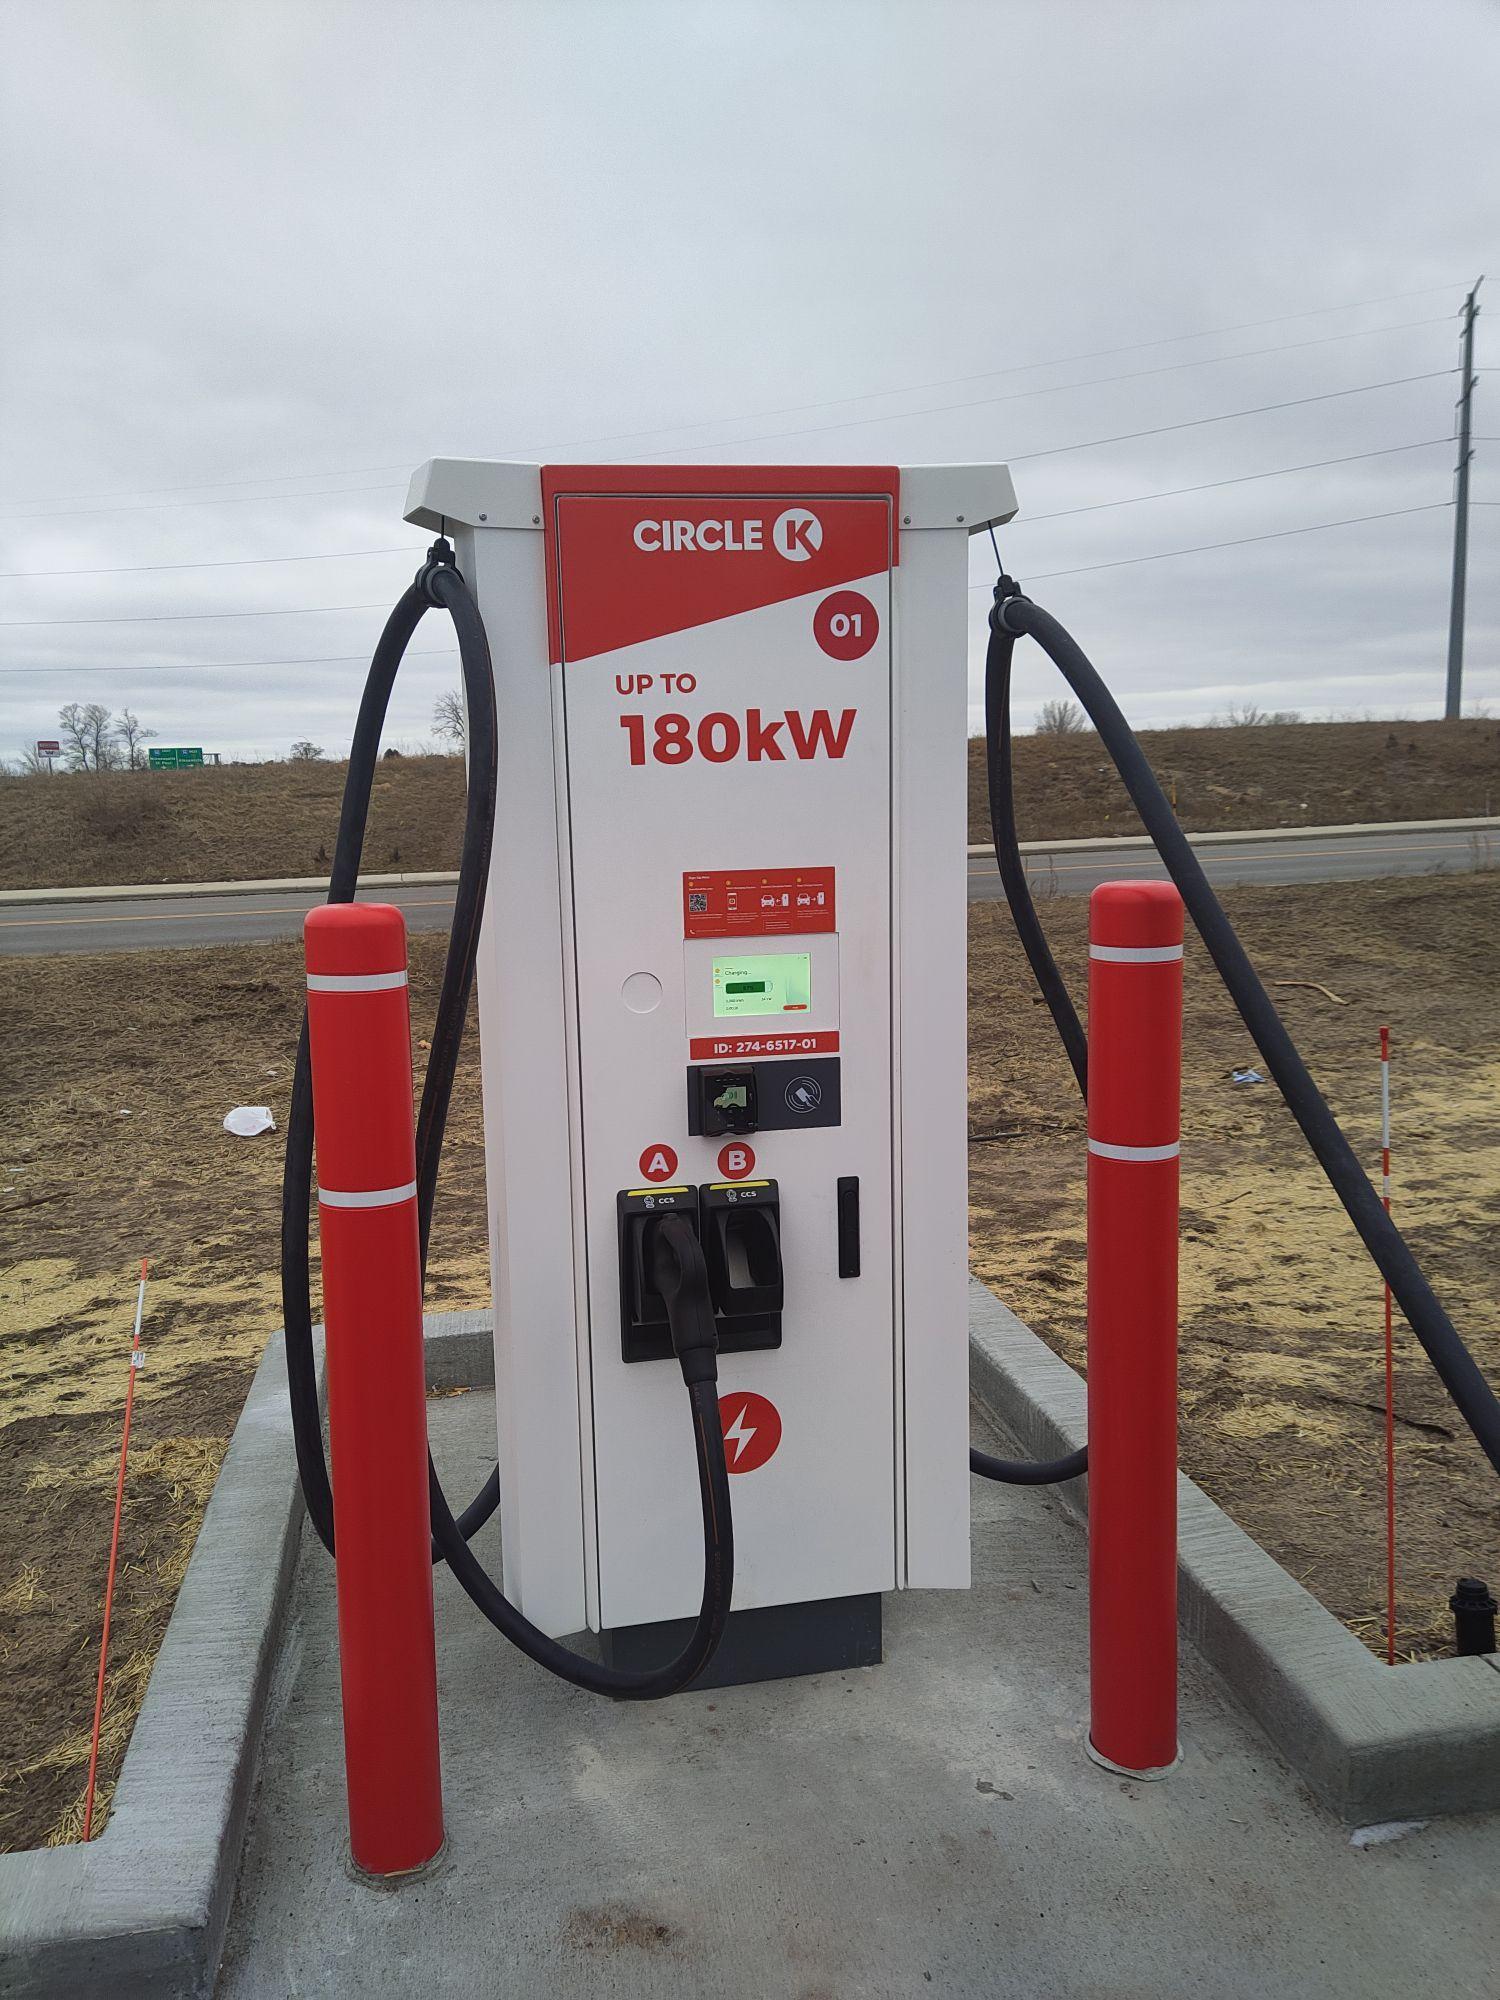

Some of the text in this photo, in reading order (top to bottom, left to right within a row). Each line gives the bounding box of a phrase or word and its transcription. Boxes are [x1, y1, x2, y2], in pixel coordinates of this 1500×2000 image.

[633, 518, 820, 558] CIRCLE K
[829, 613, 863, 638] 01
[615, 673, 697, 695] UP TO
[619, 708, 858, 766] 180kW
[713, 1038, 817, 1054] ID: 274-6517-01
[647, 1152, 669, 1173] A
[728, 1150, 747, 1171] B
[658, 1197, 675, 1205] CCS
[740, 1190, 757, 1198] CCS
